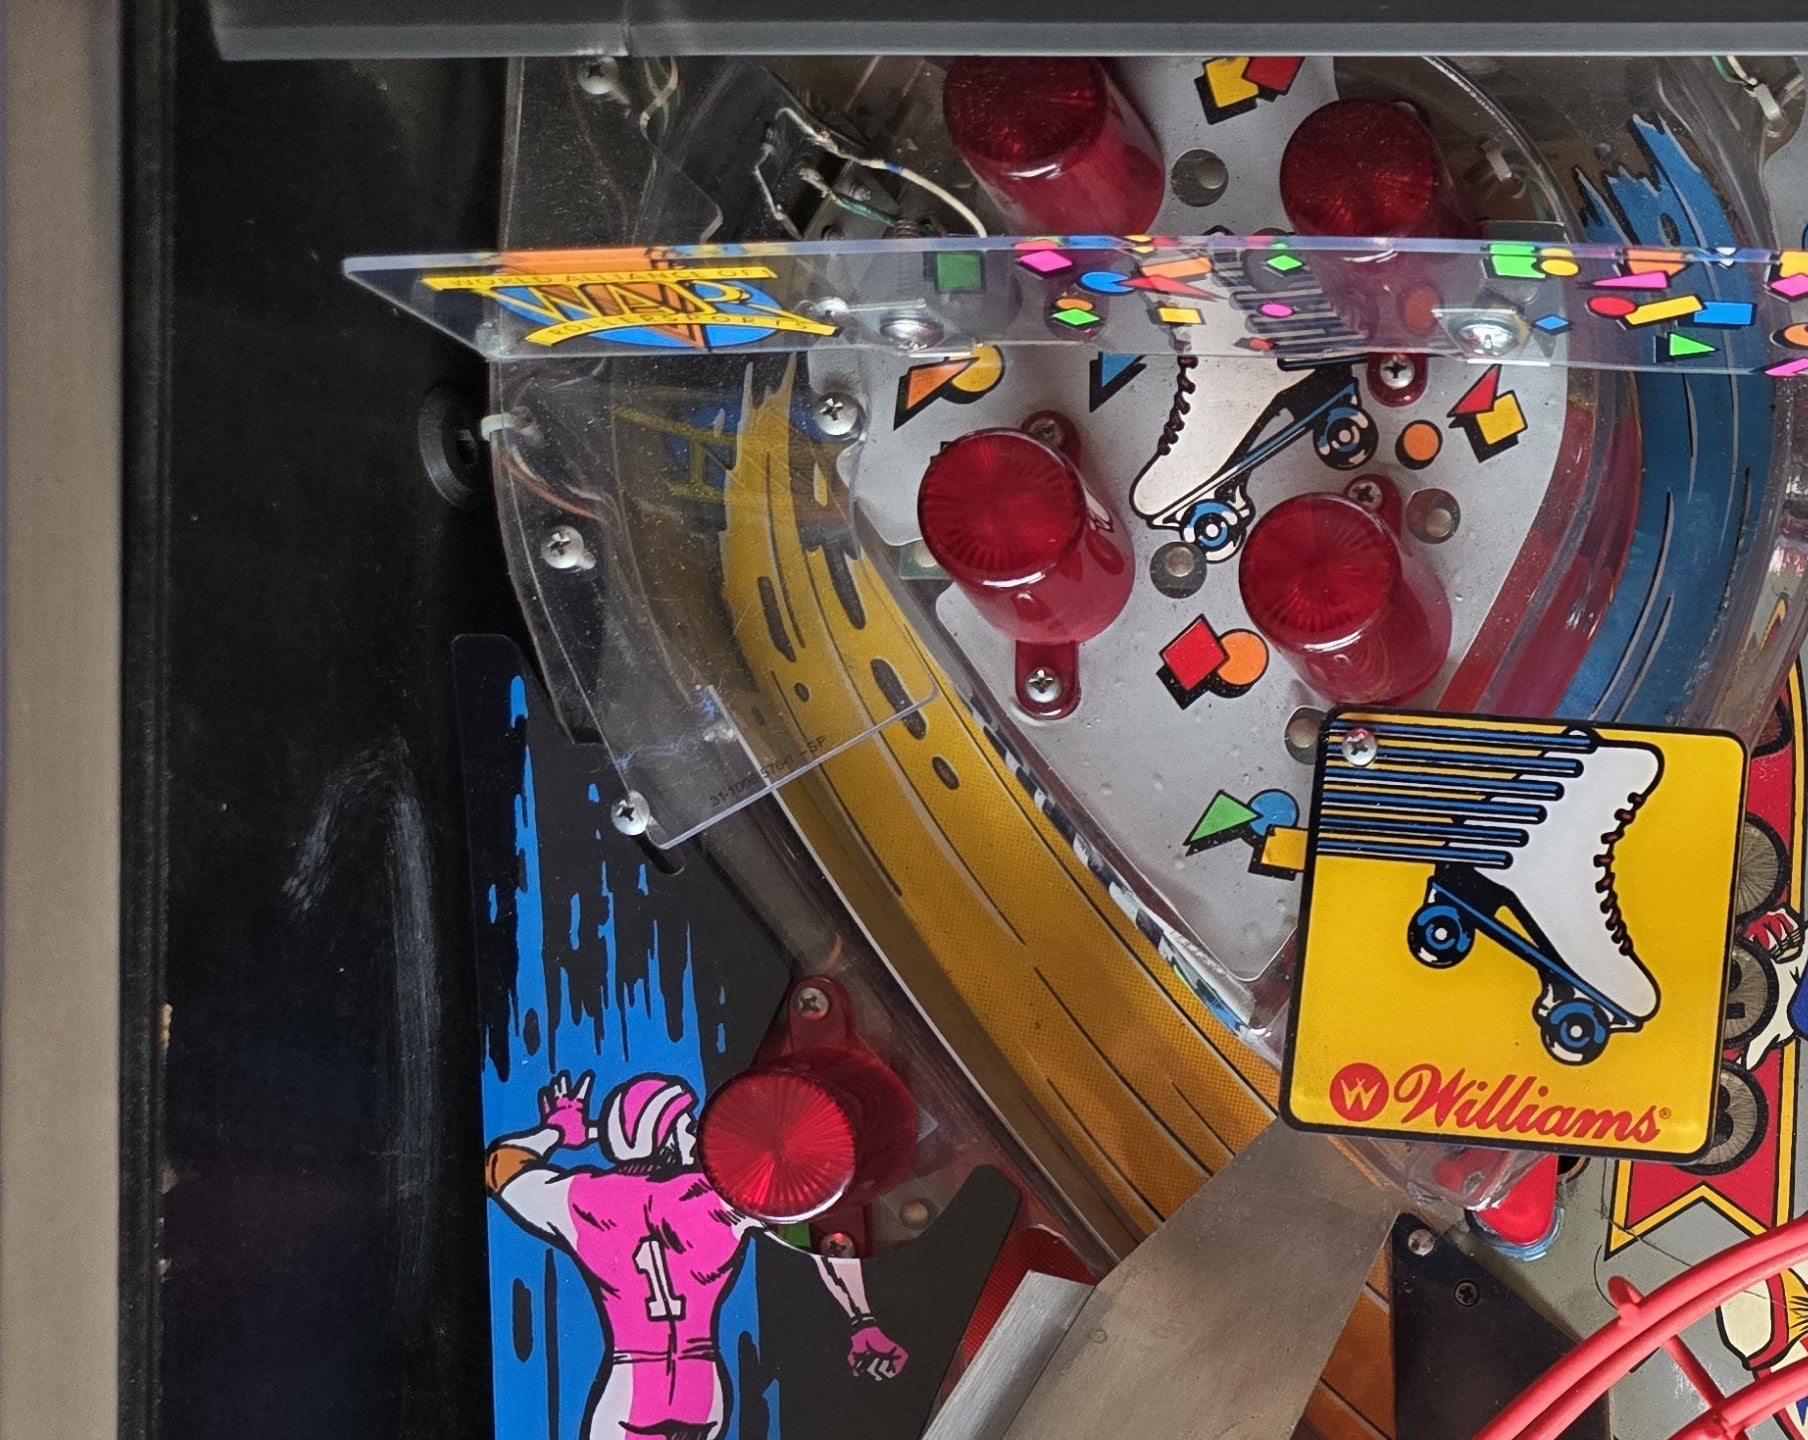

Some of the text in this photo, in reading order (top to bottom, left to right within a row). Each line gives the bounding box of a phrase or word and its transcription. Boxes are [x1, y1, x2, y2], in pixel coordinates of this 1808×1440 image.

[454, 275, 559, 288] WORLD
[565, 270, 700, 285] ALLIANCE
[476, 279, 820, 326] WAR
[546, 311, 810, 338] ROLLERSPORTS
[635, 1238, 686, 1324] 1
